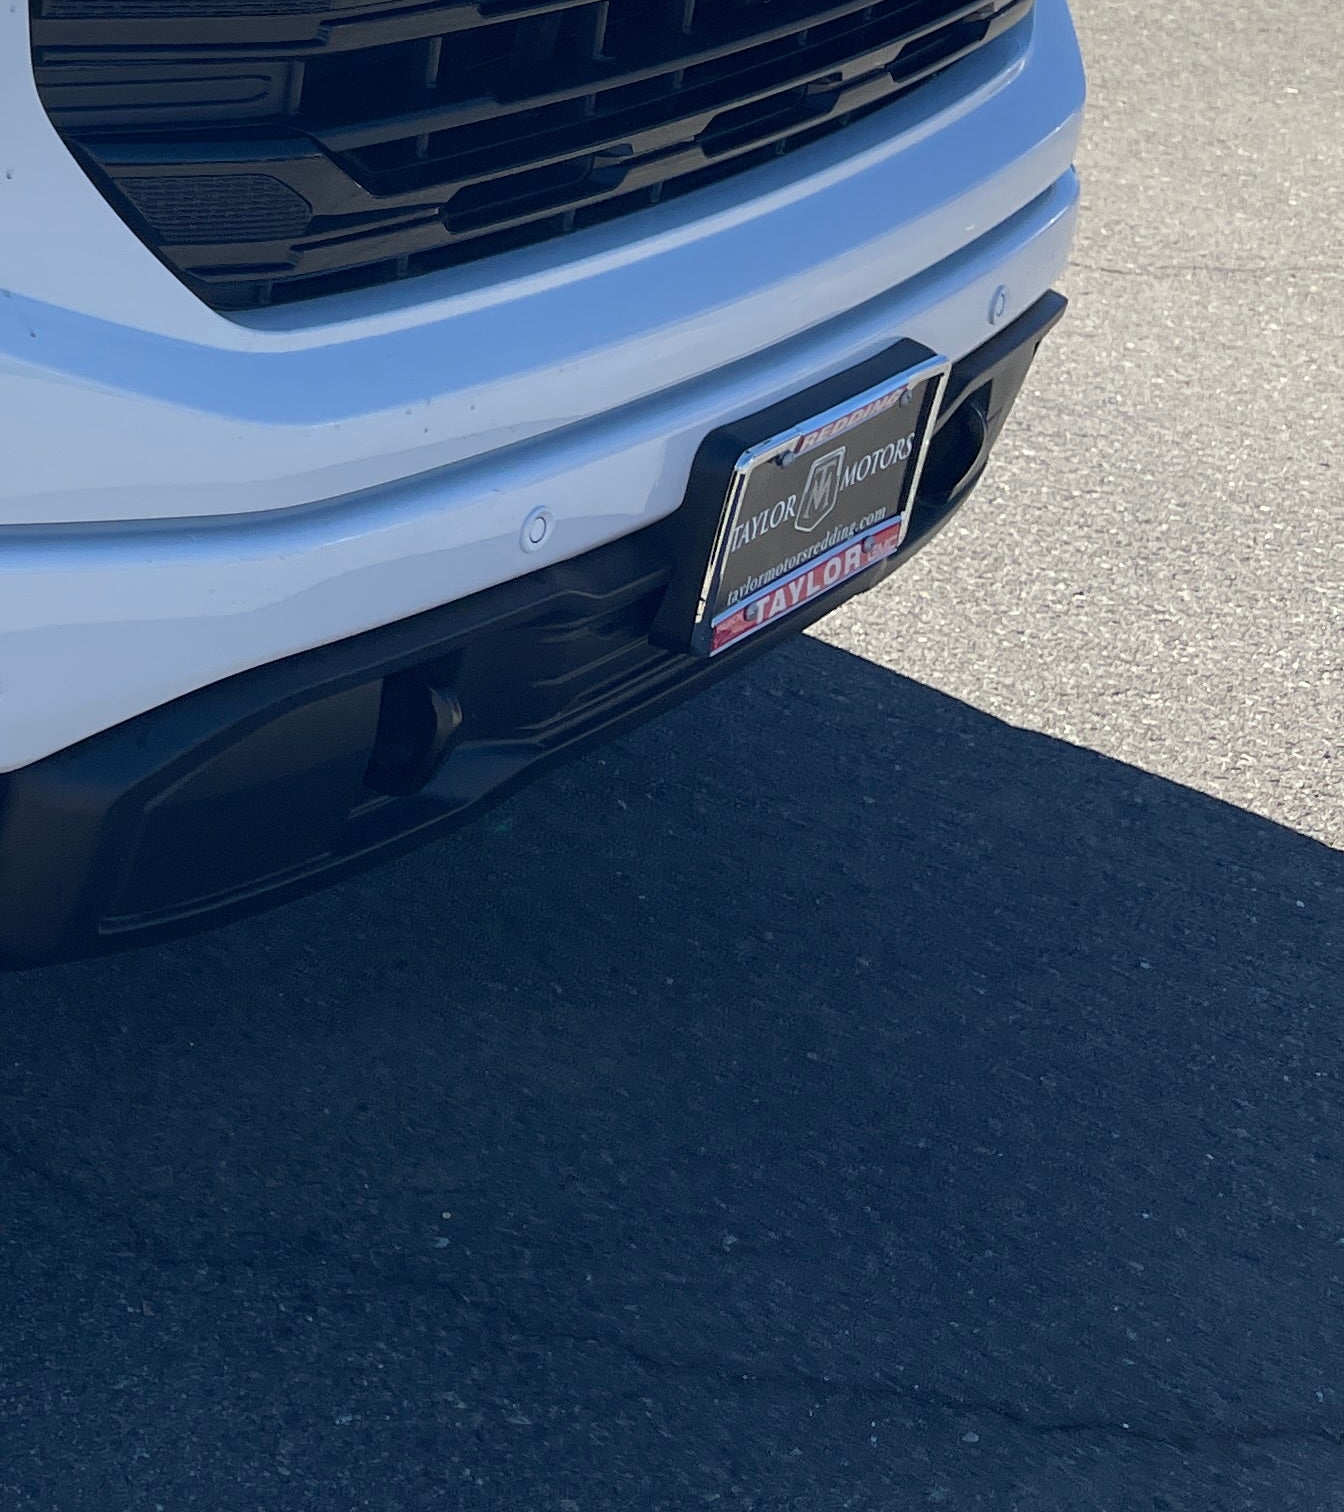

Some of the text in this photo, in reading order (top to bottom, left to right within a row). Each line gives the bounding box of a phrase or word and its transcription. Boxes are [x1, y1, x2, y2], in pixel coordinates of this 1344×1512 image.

[800, 388, 904, 450] REDDING
[731, 494, 797, 552] TAYLOR
[839, 433, 915, 491] MOTORS
[727, 507, 886, 606] taylormotorsredding.com
[755, 544, 862, 624] TAYLOR
